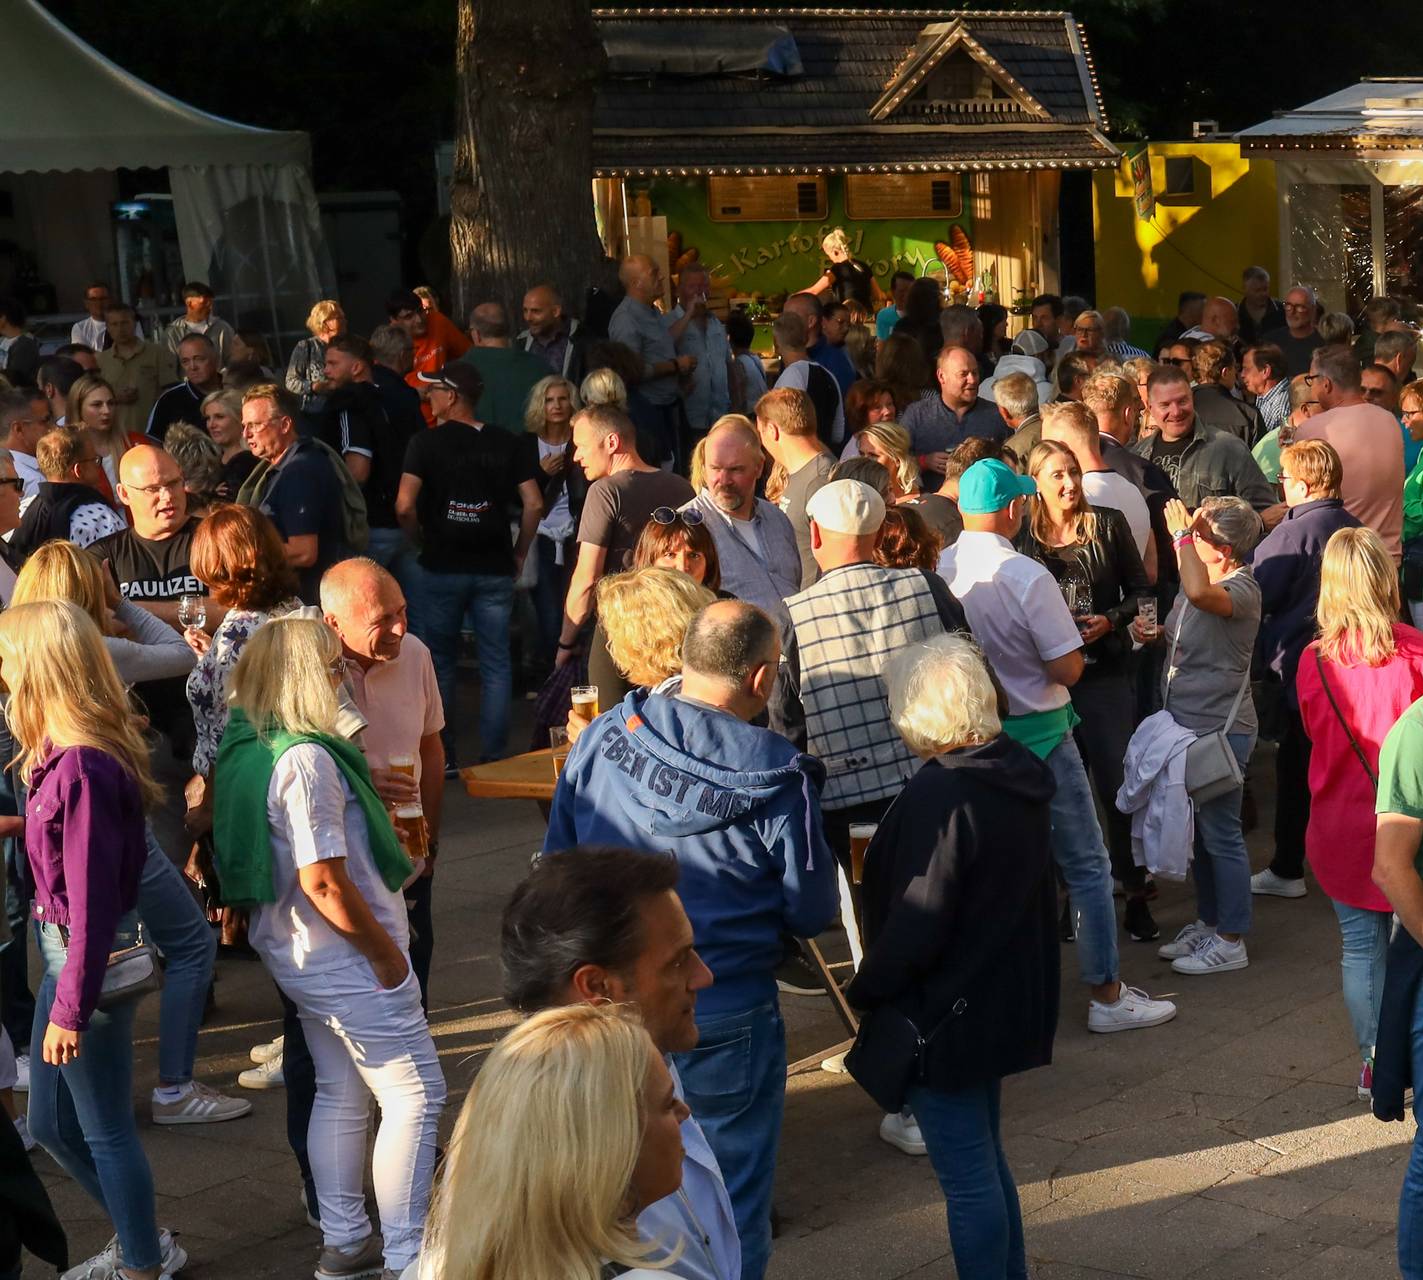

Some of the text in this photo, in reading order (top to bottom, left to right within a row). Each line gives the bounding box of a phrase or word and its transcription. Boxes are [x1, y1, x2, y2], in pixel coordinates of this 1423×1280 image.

[730, 224, 864, 274] Kartofl
[601, 724, 650, 782] EBEN
[647, 763, 699, 805] IST
